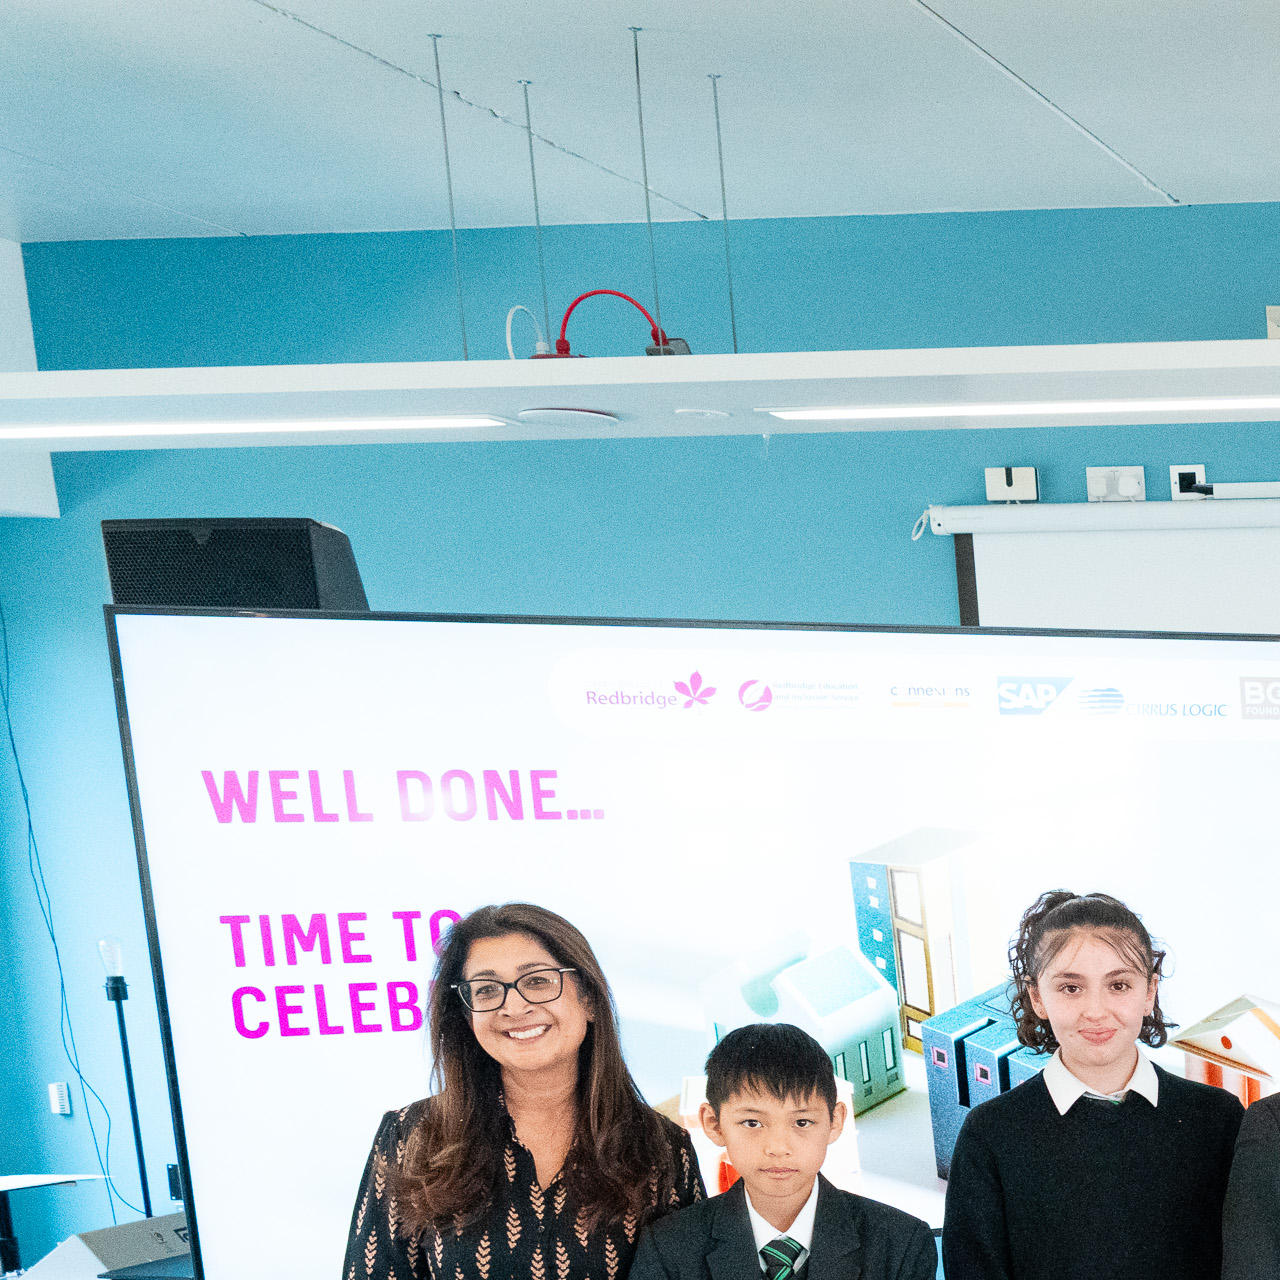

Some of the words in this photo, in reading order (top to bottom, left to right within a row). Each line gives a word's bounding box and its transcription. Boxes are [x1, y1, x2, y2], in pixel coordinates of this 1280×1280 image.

[818, 682, 859, 690] Education
[997, 682, 1058, 709] SAP
[586, 690, 678, 710] Redbridge
[1126, 703, 1177, 717] CIRRUS
[1182, 703, 1228, 717] LOGIC
[201, 770, 374, 823] WELL
[396, 769, 605, 822] DONE...
[219, 912, 372, 967] TIME
[231, 981, 426, 1039] CELEB
